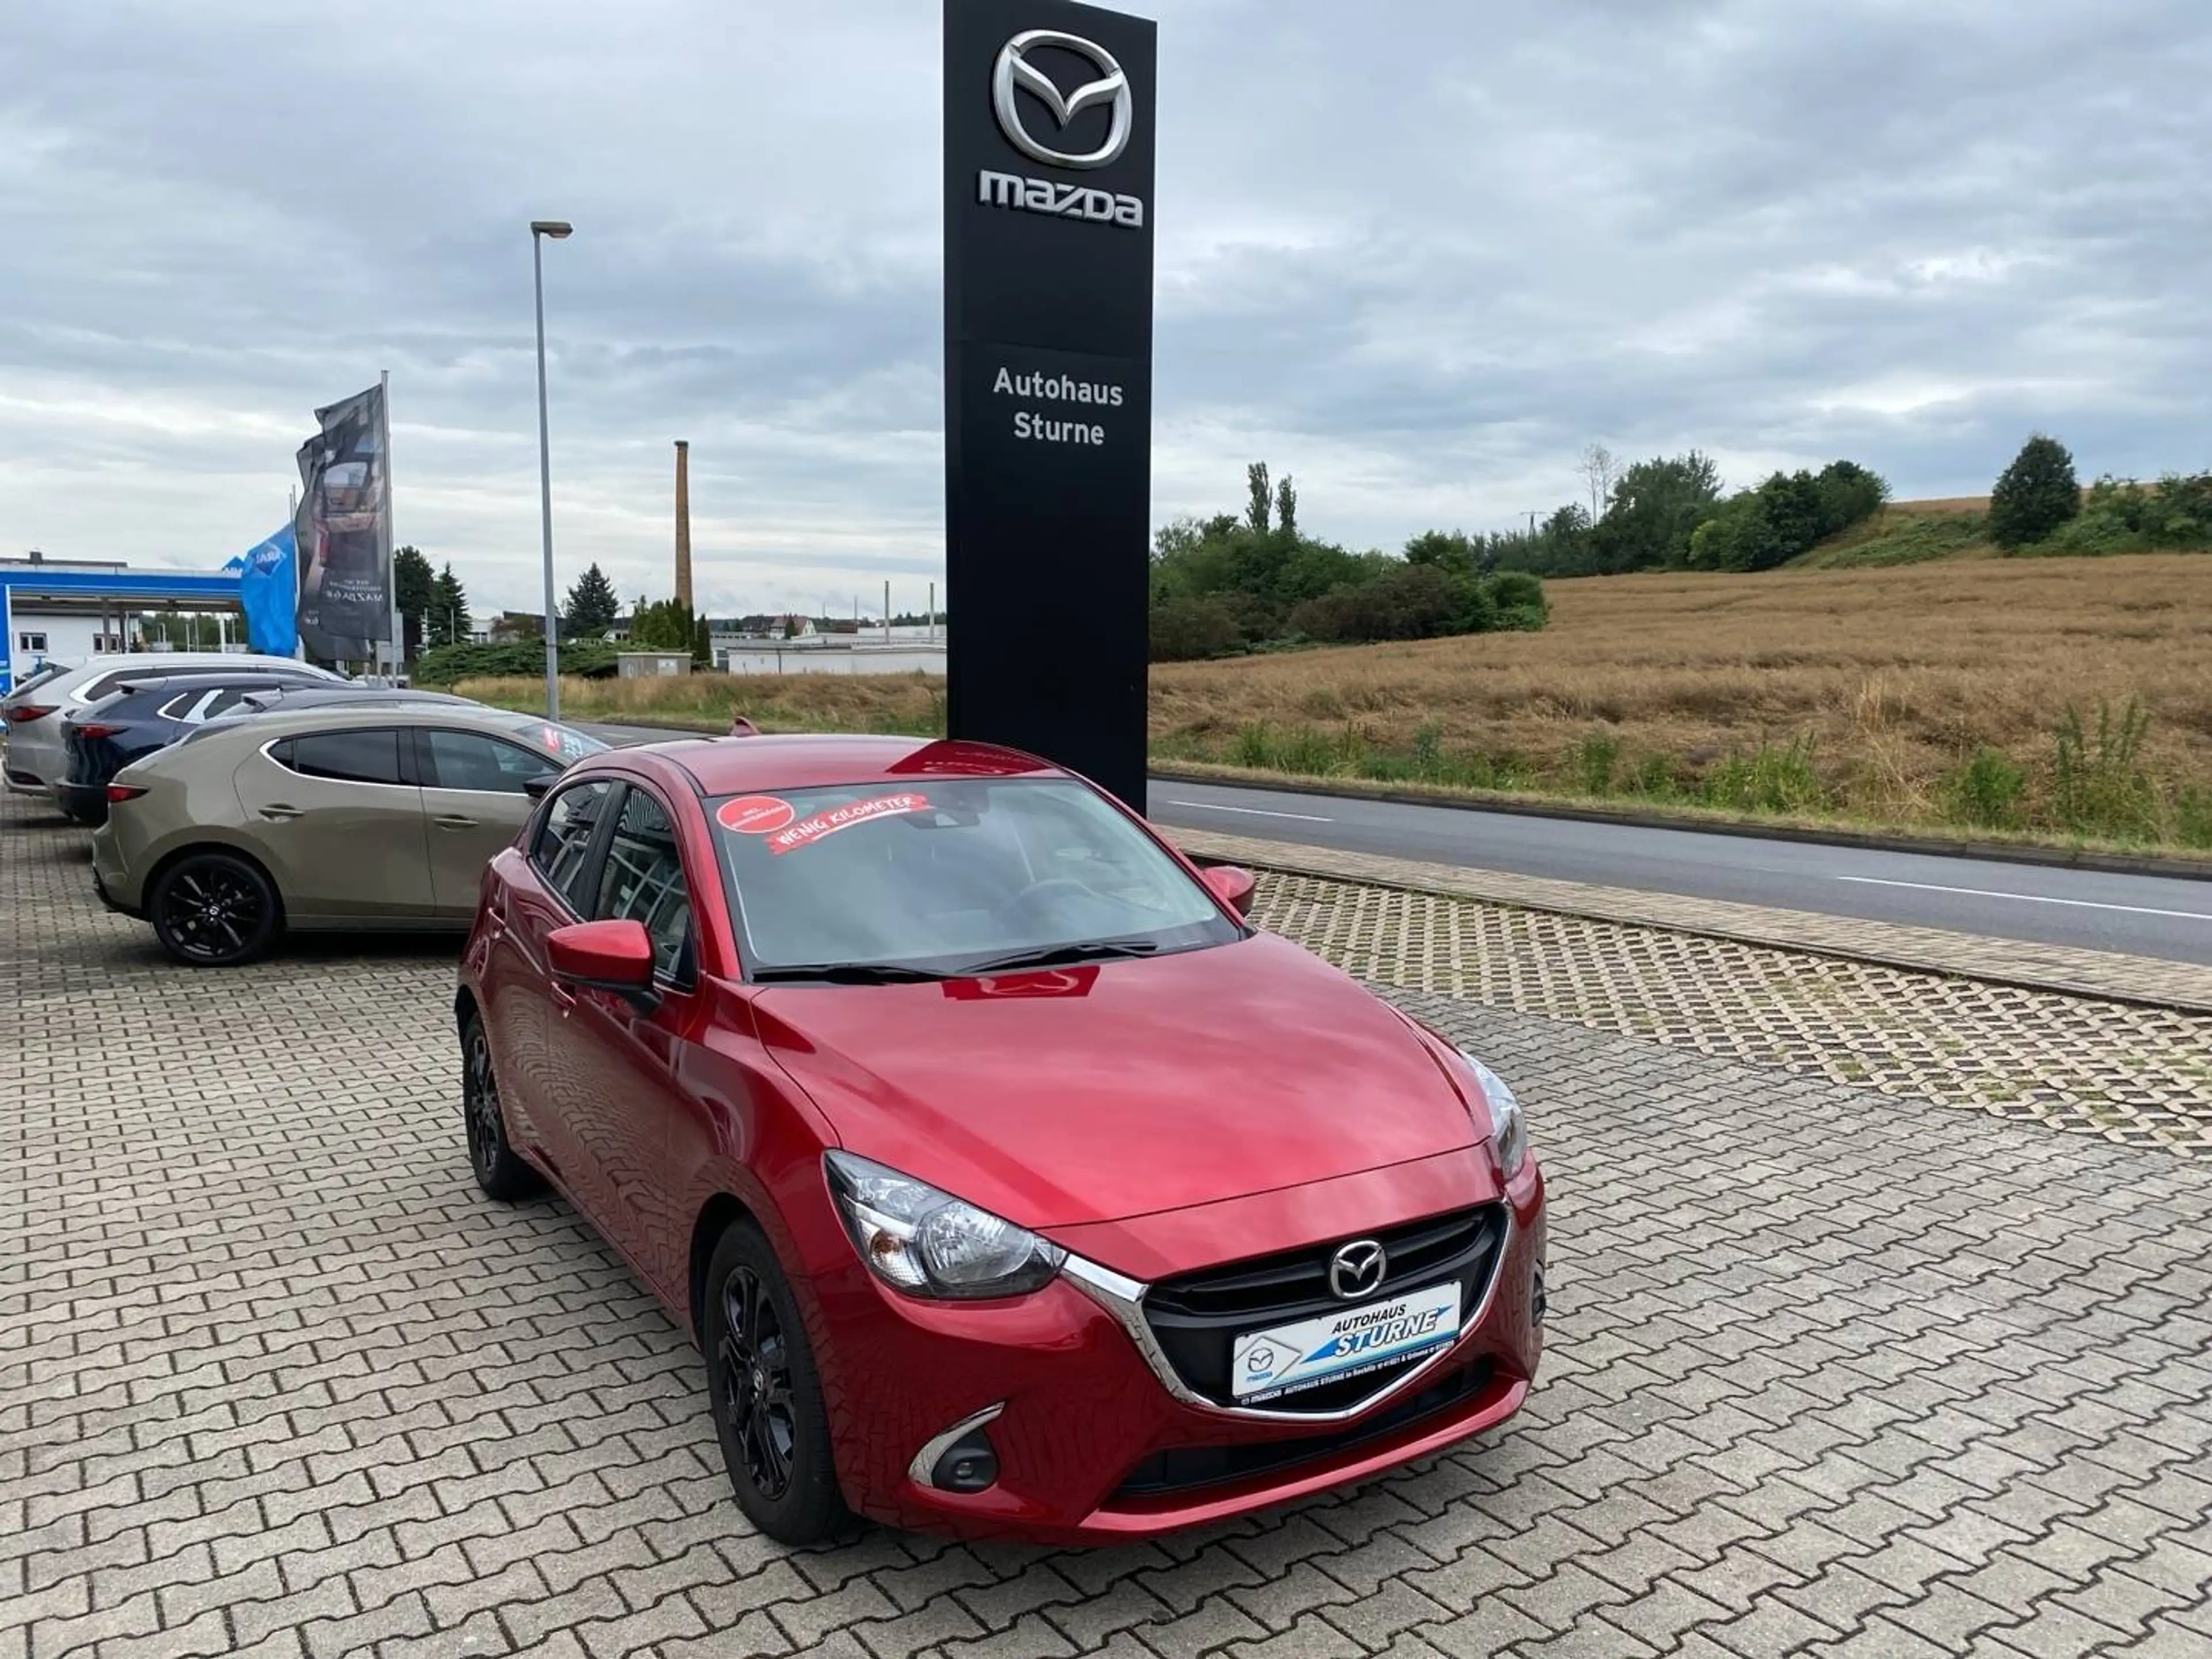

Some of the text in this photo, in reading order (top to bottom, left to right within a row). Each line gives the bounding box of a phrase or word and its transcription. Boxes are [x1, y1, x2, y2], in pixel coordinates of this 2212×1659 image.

[980, 169, 1143, 228] mazda
[993, 367, 1123, 406] Autohaus
[1014, 411, 1104, 445] Sturne
[778, 797, 917, 845] WENIG KILOMETER
[1332, 1304, 1406, 1334] AUTOHAUS
[1335, 1308, 1438, 1357] STURNE
